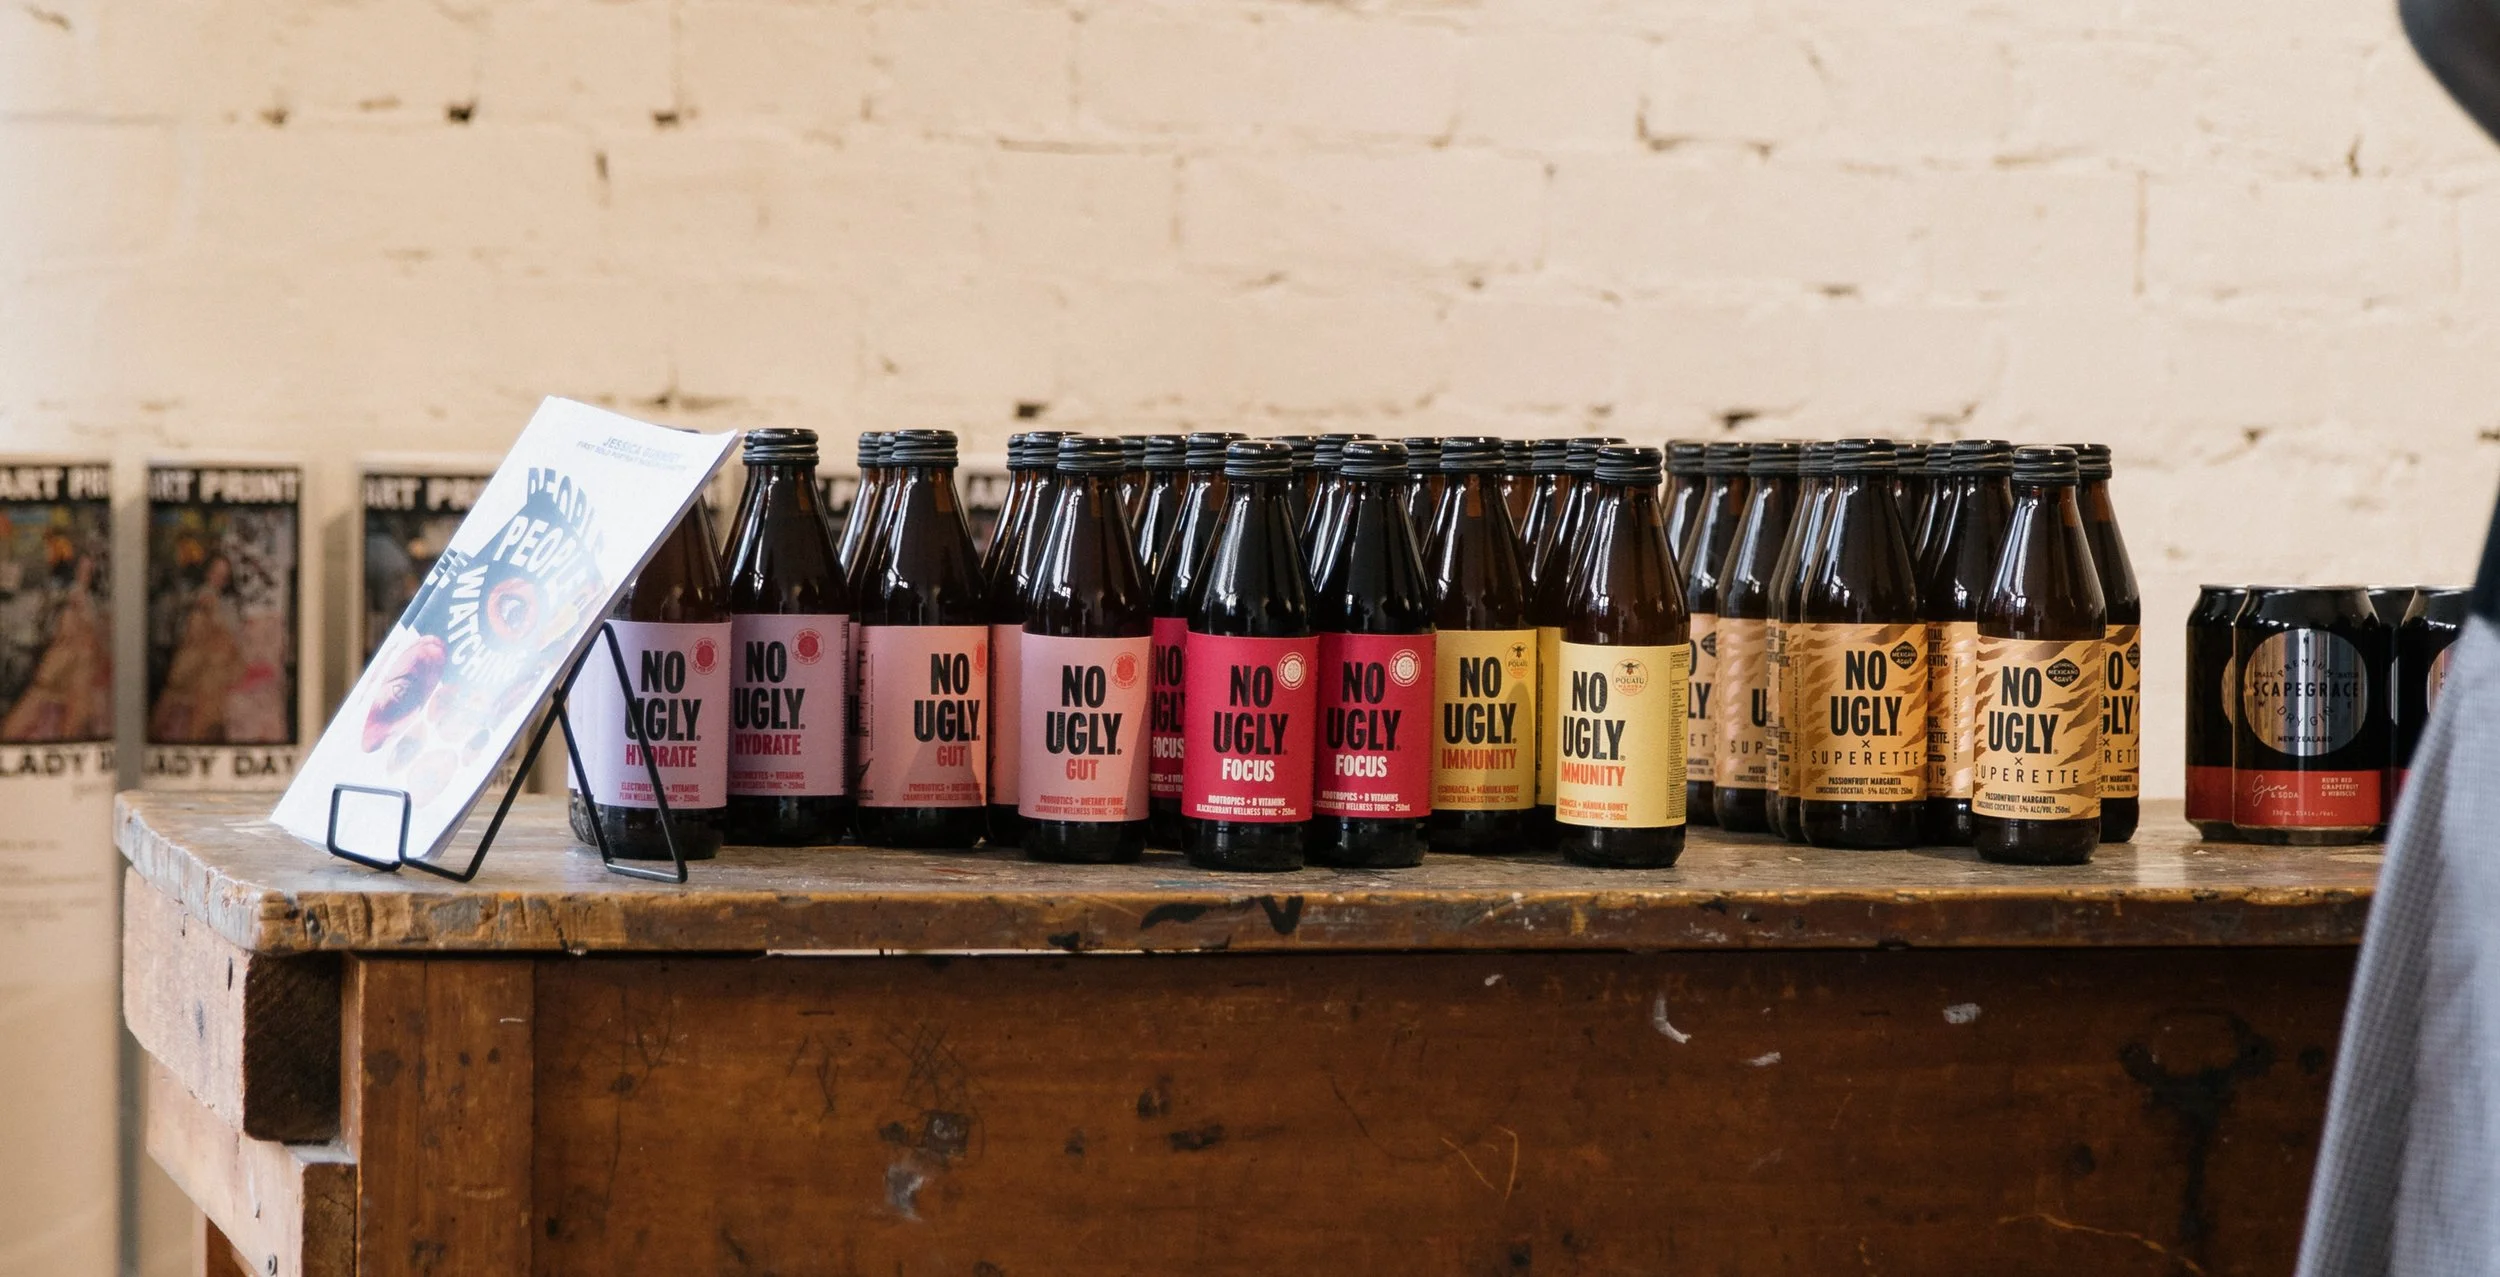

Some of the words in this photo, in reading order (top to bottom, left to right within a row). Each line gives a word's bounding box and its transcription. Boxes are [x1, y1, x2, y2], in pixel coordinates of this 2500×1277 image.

[640, 650, 686, 694] NO
[745, 641, 787, 684] NO
[930, 652, 970, 695] NO
[1154, 645, 1183, 686] NO
[1845, 650, 1887, 692] NO
[2048, 668, 2079, 676] MEXICANO
[1061, 665, 1106, 708] NO
[1229, 665, 1274, 708] NO
[1342, 661, 1386, 705] NO
[1459, 656, 1502, 698] NO
[2001, 665, 2043, 709] NO
[2052, 675, 2074, 683] AGAVE
[1571, 670, 1608, 714] NO
[2253, 681, 2359, 697] SCAPEGRACE
[2276, 705, 2304, 727] DRY
[734, 734, 802, 756] HYDRATE
[1153, 736, 1185, 759] FOCUS
[2277, 735, 2298, 743] NEW
[2297, 735, 2333, 743] ZEALAND
[936, 745, 966, 767] GUT
[1335, 754, 1388, 778] FOCUS
[1441, 748, 1518, 770] IMMUNITY
[1811, 751, 1919, 766] SUPERETTE
[1065, 758, 1099, 781] GUT
[1222, 758, 1275, 782] FOCUS
[1561, 761, 1626, 787] IMMUNITY
[1828, 776, 1869, 785] PASSIONFRUIT
[1870, 777, 1902, 786] MARGARITA
[1974, 765, 2080, 784] SUPERETTE
[1840, 786, 1865, 795] COCKTAIL
[1867, 786, 1878, 795] 5%
[1984, 791, 2021, 804] PASSIONFRUIT
[2021, 794, 2056, 805] MARGARITA
[2252, 774, 2288, 807] Gin
[2278, 791, 2299, 799] SODA
[1994, 803, 2016, 813] COCKTAIL
[2030, 806, 2052, 814] ALC/VOL
